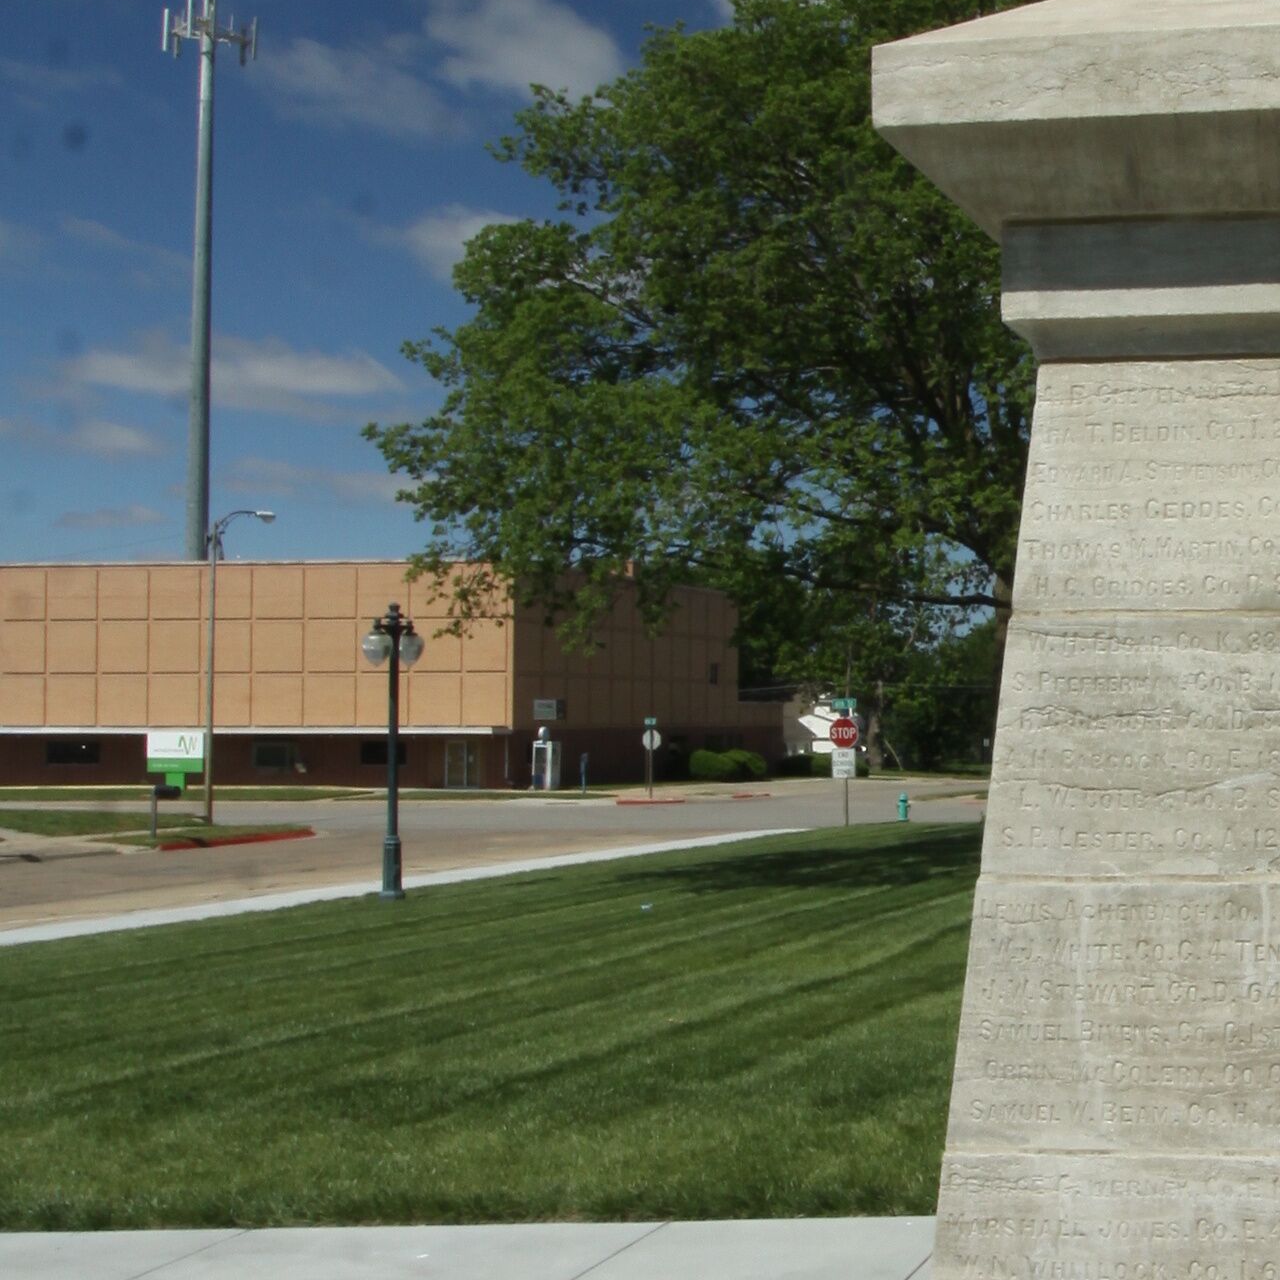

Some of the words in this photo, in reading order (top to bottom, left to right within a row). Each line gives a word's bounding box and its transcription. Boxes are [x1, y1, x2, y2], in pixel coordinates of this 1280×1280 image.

[1030, 500, 1131, 521] CHARLES
[1023, 538, 1121, 560] THOMAS
[831, 727, 856, 739] STOP
[978, 1019, 1068, 1042] SAMUEL
[970, 1099, 1061, 1122] SAMUEL
